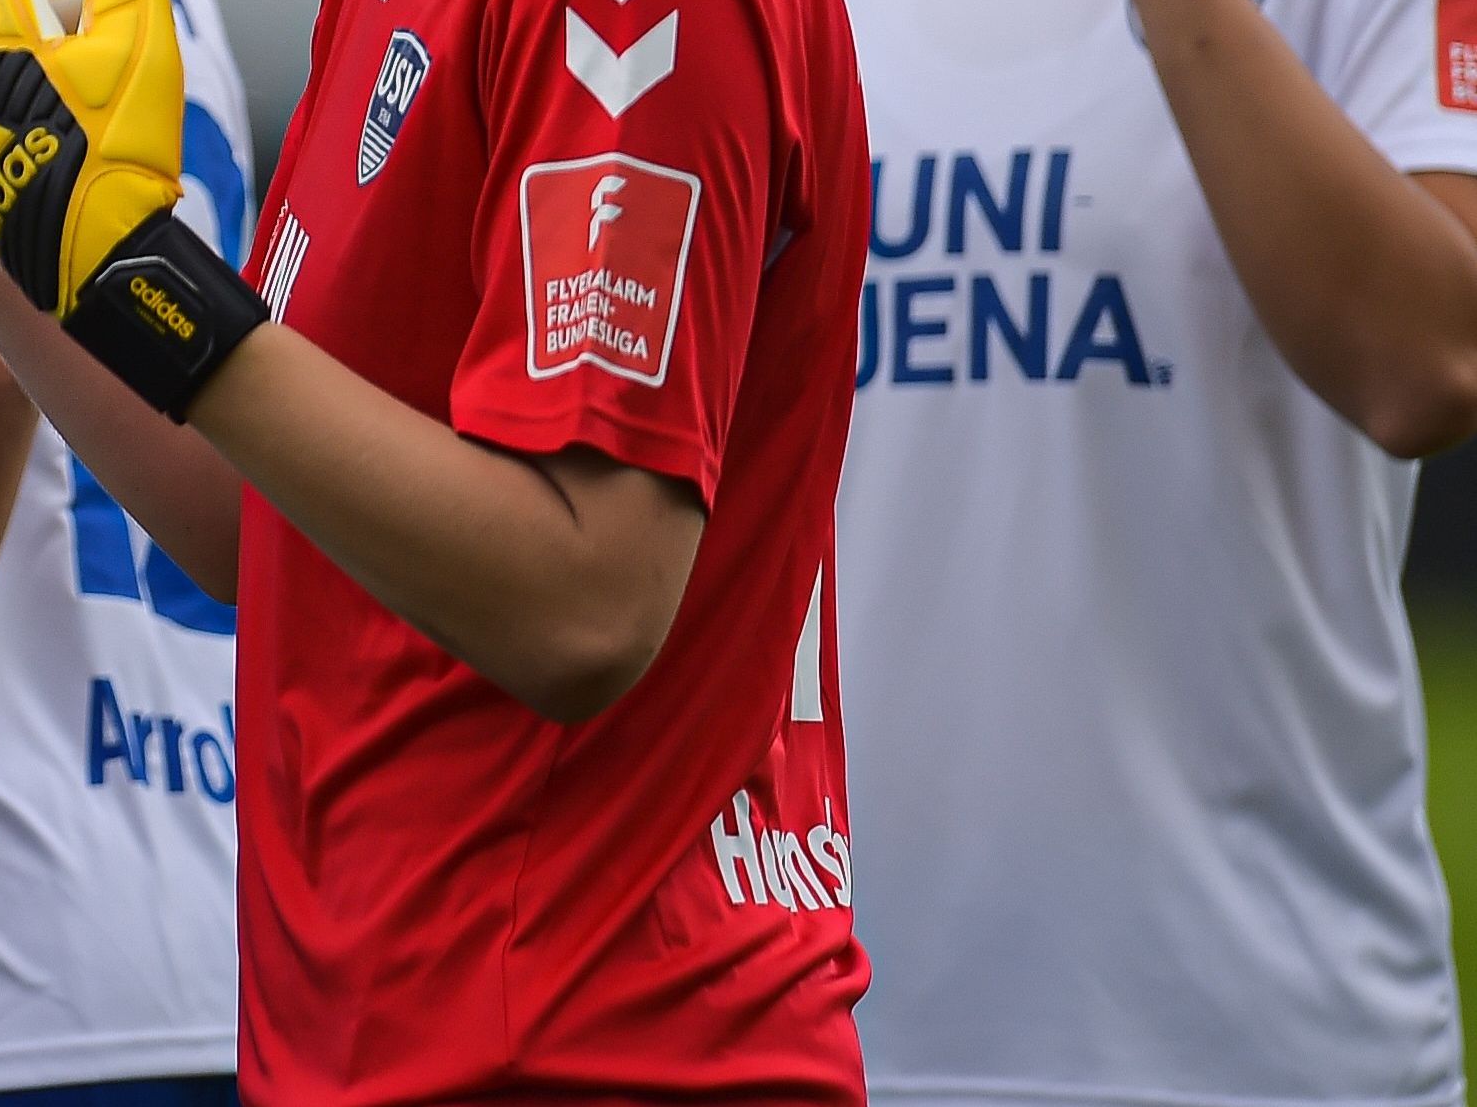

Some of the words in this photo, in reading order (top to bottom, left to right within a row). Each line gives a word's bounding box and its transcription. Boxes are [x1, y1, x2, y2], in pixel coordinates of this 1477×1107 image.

[377, 47, 422, 114] USV
[868, 148, 1093, 259] UNI-
[130, 277, 194, 338] adidas
[546, 268, 657, 310] FLYERALARM
[546, 291, 616, 329] FRAUEN-
[546, 316, 649, 360] BUNDESLIGA
